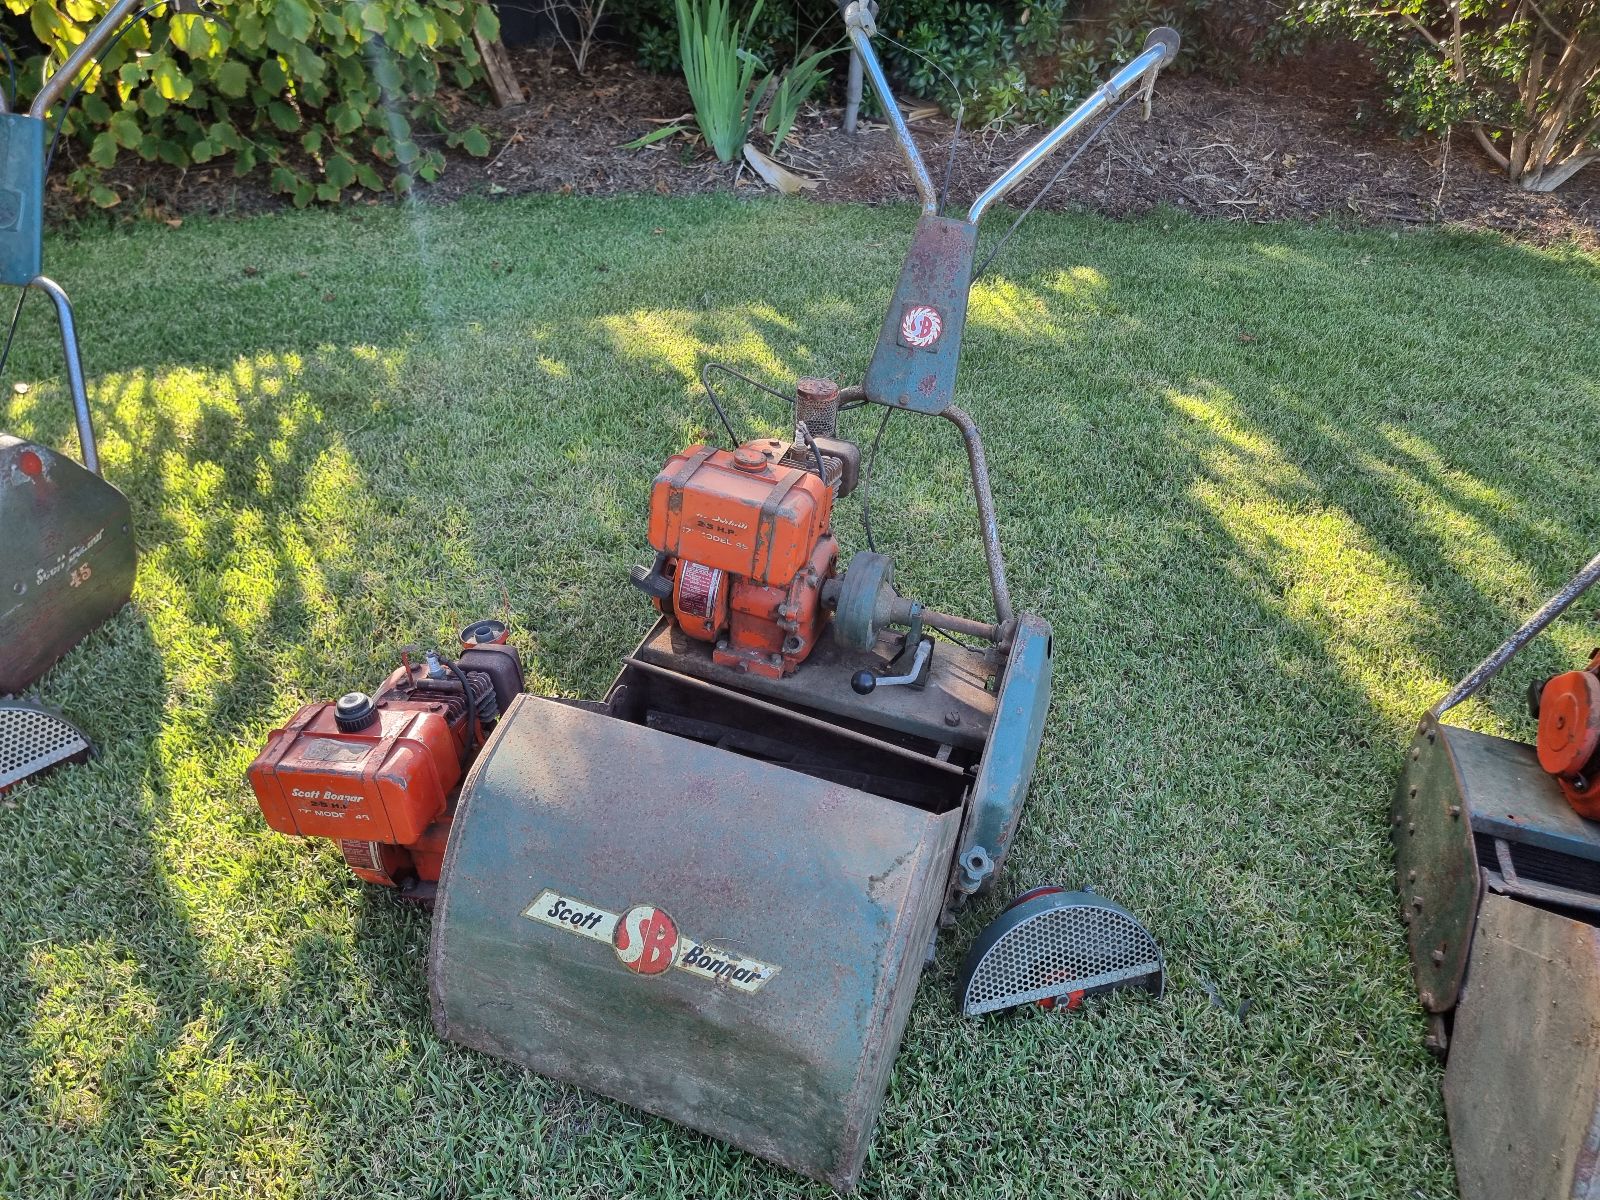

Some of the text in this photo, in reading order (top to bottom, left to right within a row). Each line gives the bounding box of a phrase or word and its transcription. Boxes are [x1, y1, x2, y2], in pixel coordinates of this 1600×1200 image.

[291, 787, 364, 803] Scott Bonnar
[547, 900, 604, 930] Scott
[682, 945, 765, 984] Bonnar
